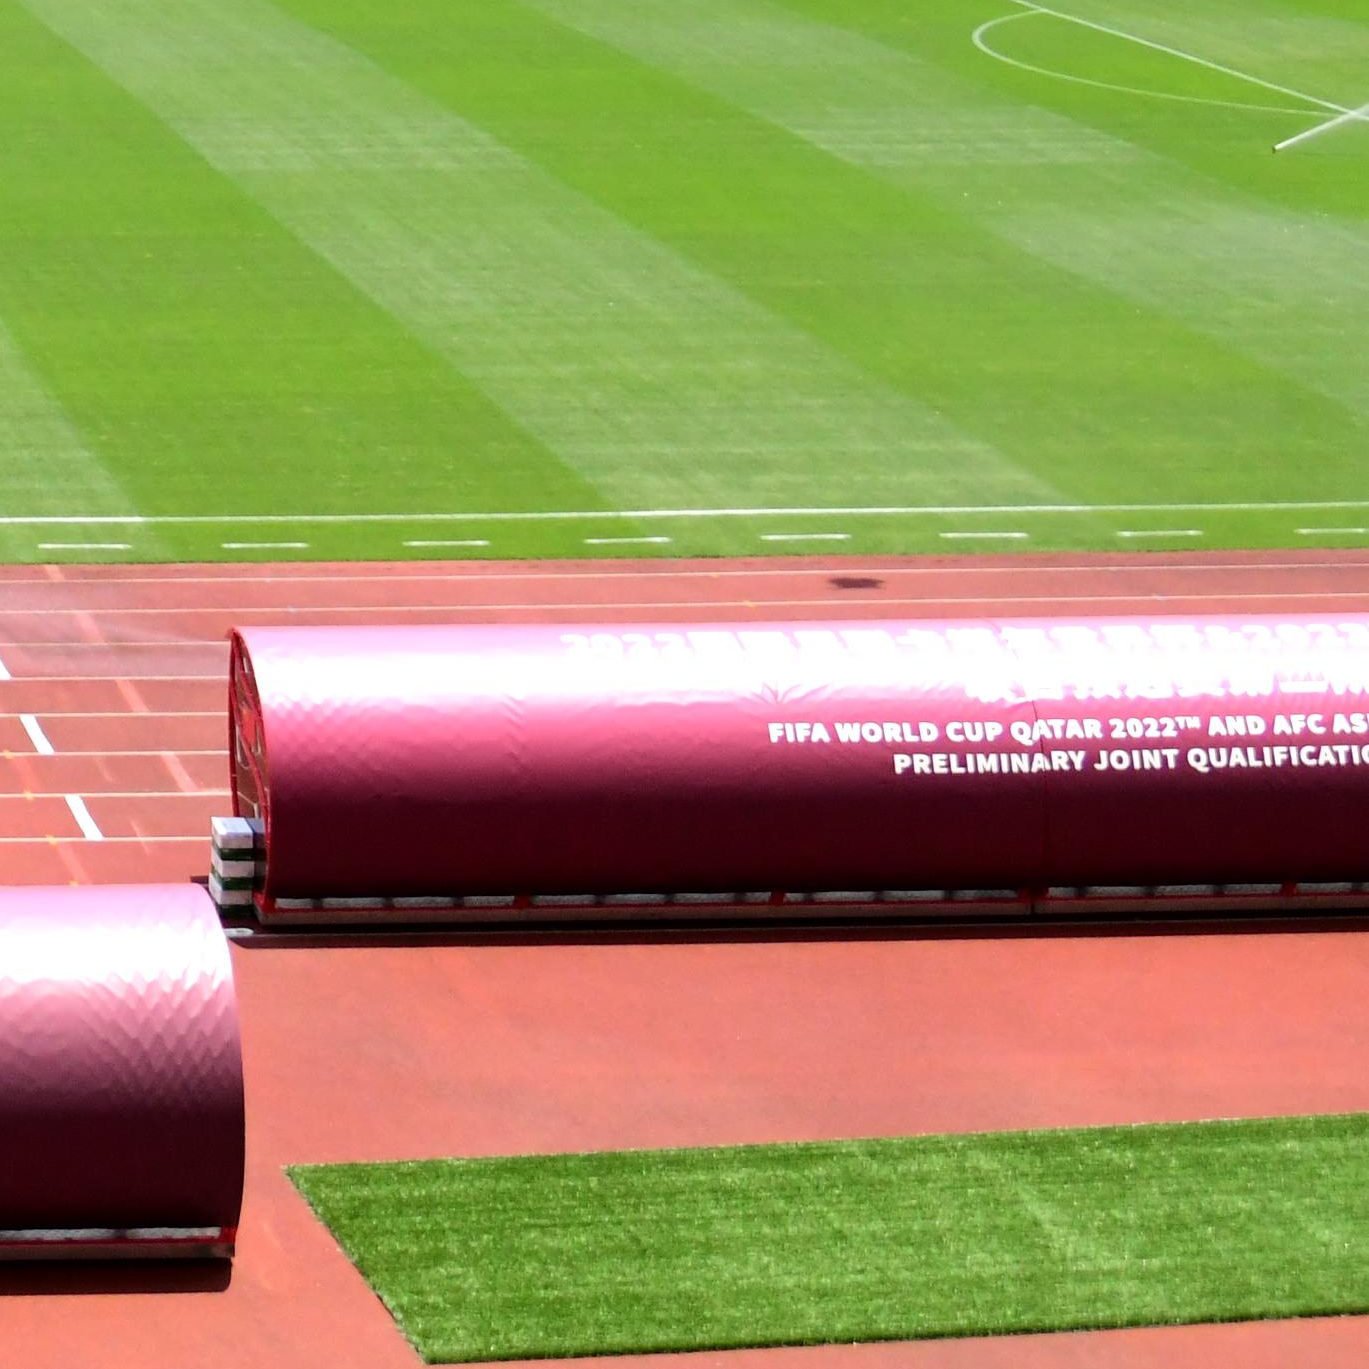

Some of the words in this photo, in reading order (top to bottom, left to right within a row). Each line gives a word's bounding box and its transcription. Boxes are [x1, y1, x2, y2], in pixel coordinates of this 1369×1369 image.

[768, 721, 830, 743] FIFA
[833, 721, 937, 743] WORLD
[945, 720, 1002, 742] CUP
[1010, 718, 1102, 747] QATAR
[1208, 714, 1266, 736] AND
[1273, 712, 1327, 735] AFC
[893, 750, 1085, 775] PRELIMINARY
[1094, 748, 1179, 772] JOINT
